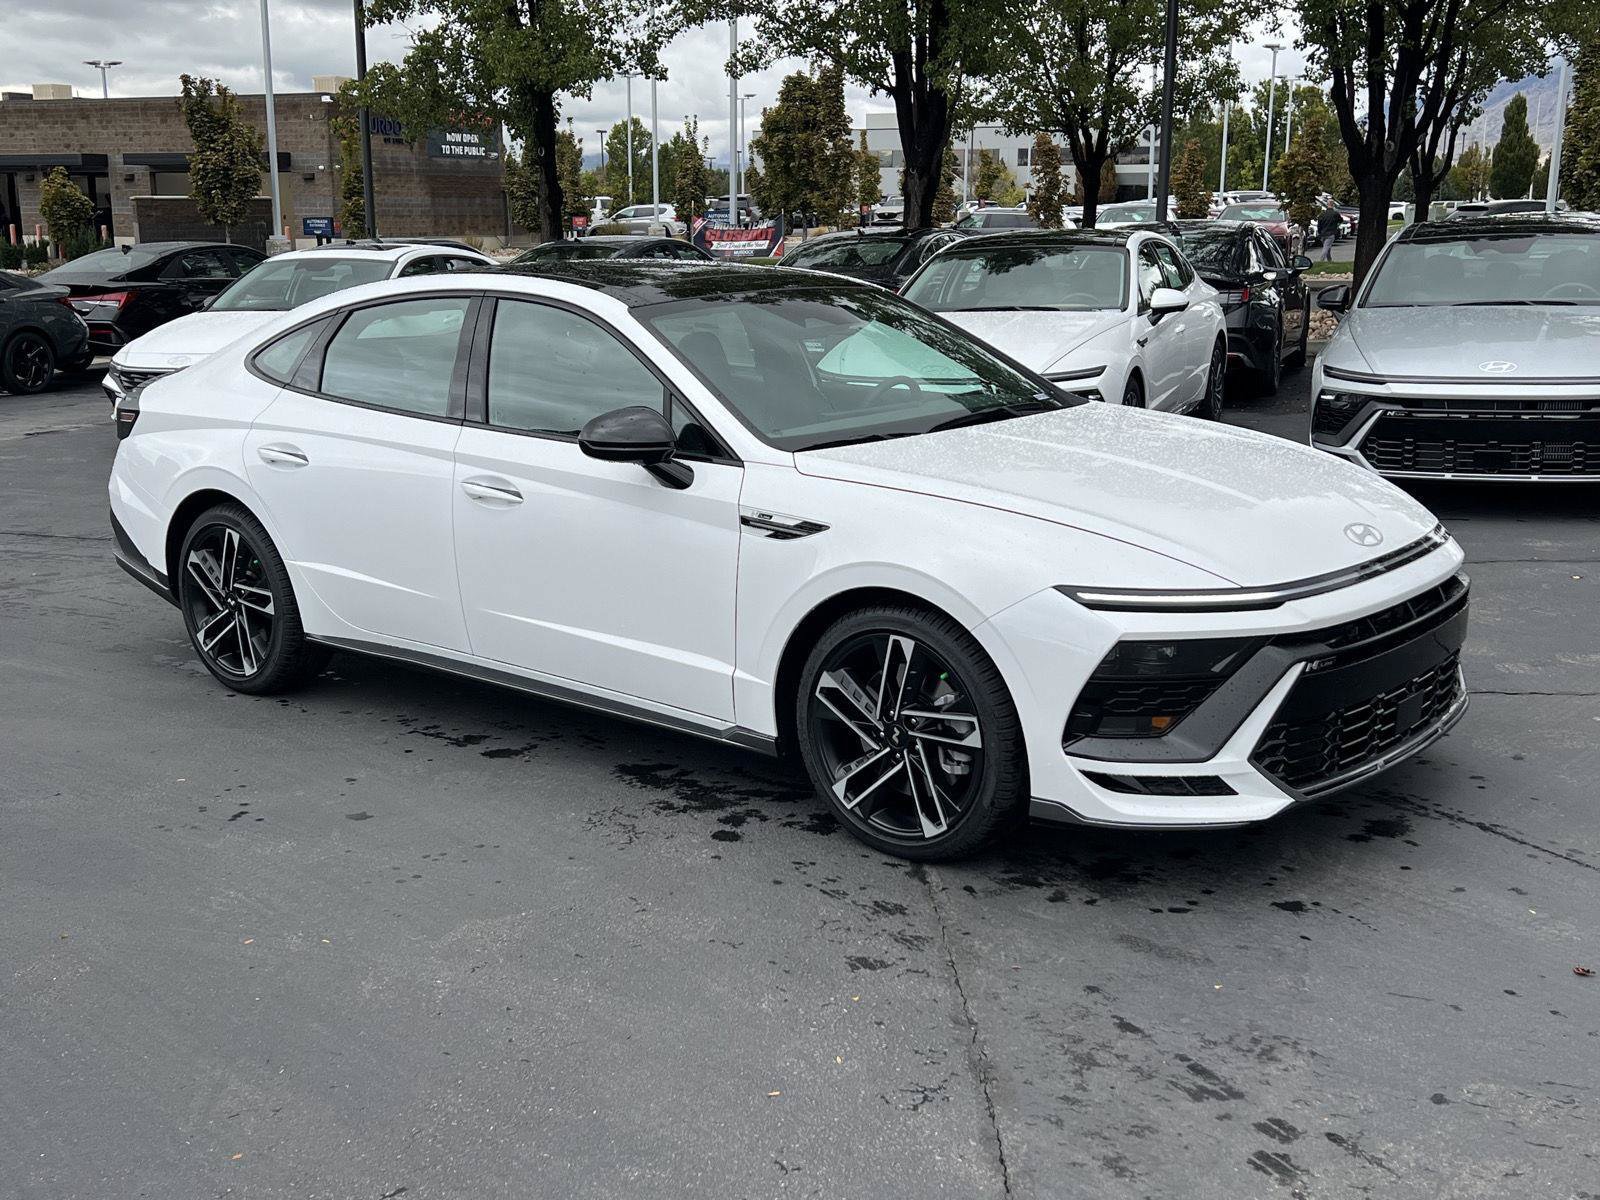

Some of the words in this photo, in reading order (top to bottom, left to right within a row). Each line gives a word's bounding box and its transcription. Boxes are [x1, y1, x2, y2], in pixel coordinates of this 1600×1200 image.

[446, 132, 461, 142] NOW
[462, 132, 479, 143] OPEN
[441, 145, 450, 154] TO
[451, 145, 463, 155] THE
[464, 146, 486, 156] PUBLIC
[705, 229, 774, 241] CLOSEOUT
